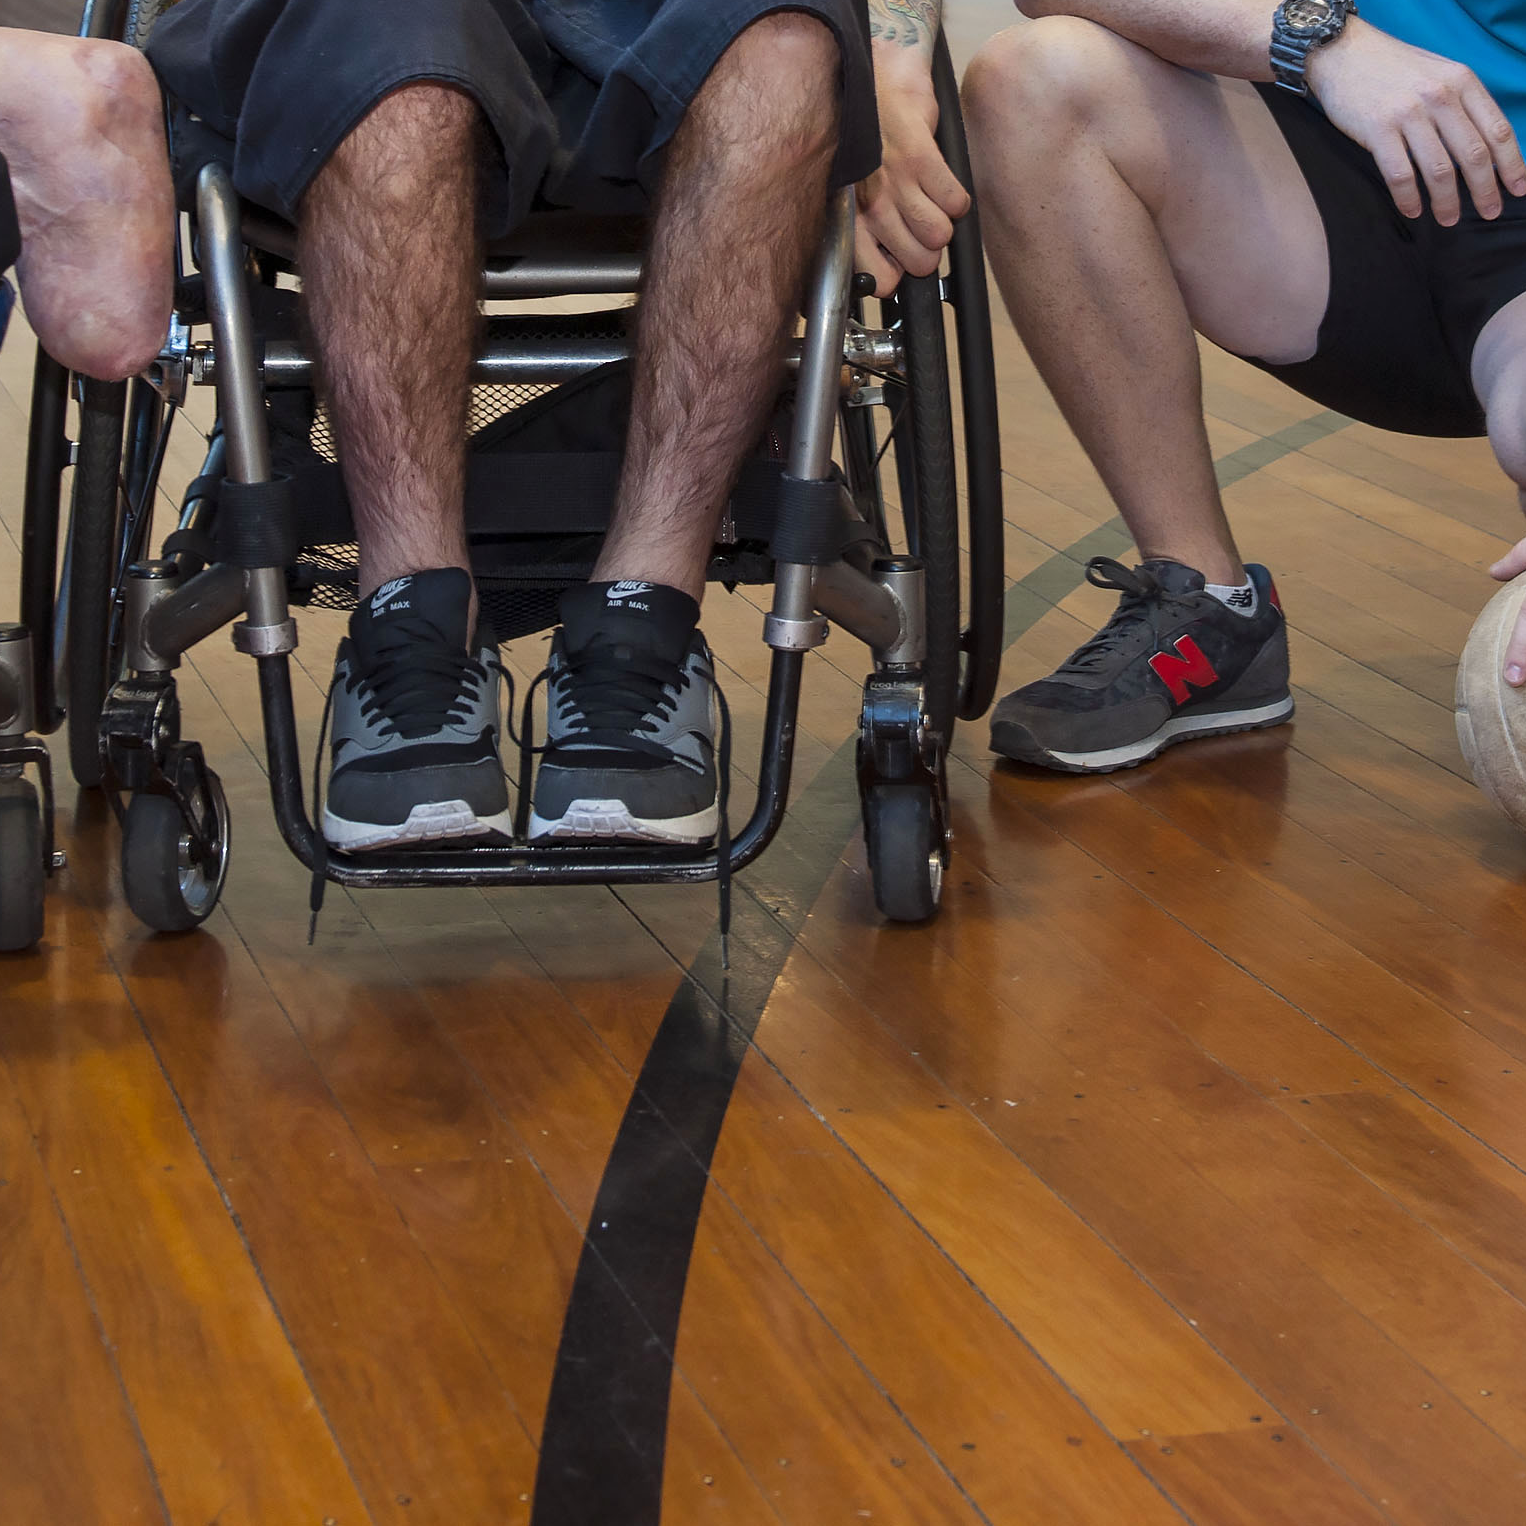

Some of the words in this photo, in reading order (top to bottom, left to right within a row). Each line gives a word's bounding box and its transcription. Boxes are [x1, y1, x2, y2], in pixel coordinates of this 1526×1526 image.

[614, 580, 654, 592] NIKE
[390, 601, 411, 610] MAX
[628, 601, 650, 612] MAX
